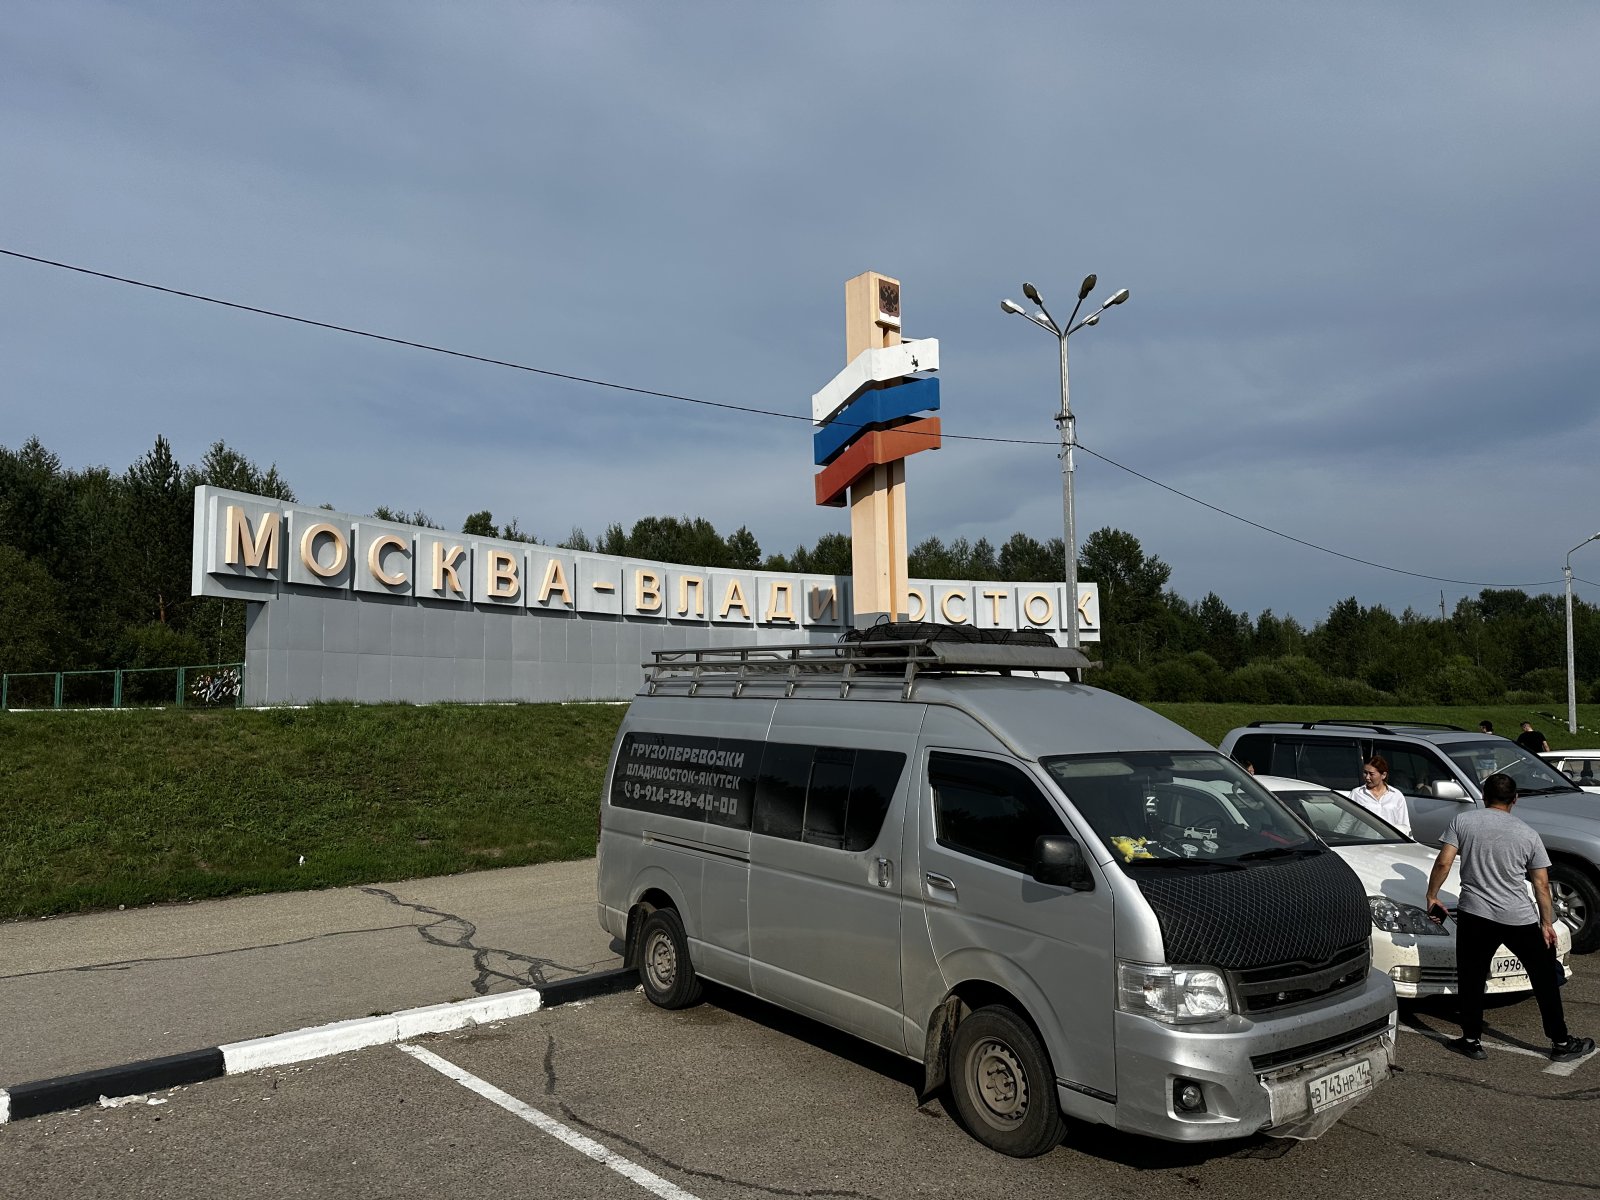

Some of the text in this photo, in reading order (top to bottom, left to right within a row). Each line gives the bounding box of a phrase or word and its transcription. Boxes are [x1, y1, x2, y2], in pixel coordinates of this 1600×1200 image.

[225, 505, 1094, 626] МОСКВА-ВЛАДИОСТОК
[630, 743, 745, 768] ГРУЗОПЕРЕВОЗКИ
[626, 763, 741, 790] ВЛАДИВОСТОК-ЯКУТСК
[633, 784, 738, 815] 8-914-228-40-00
